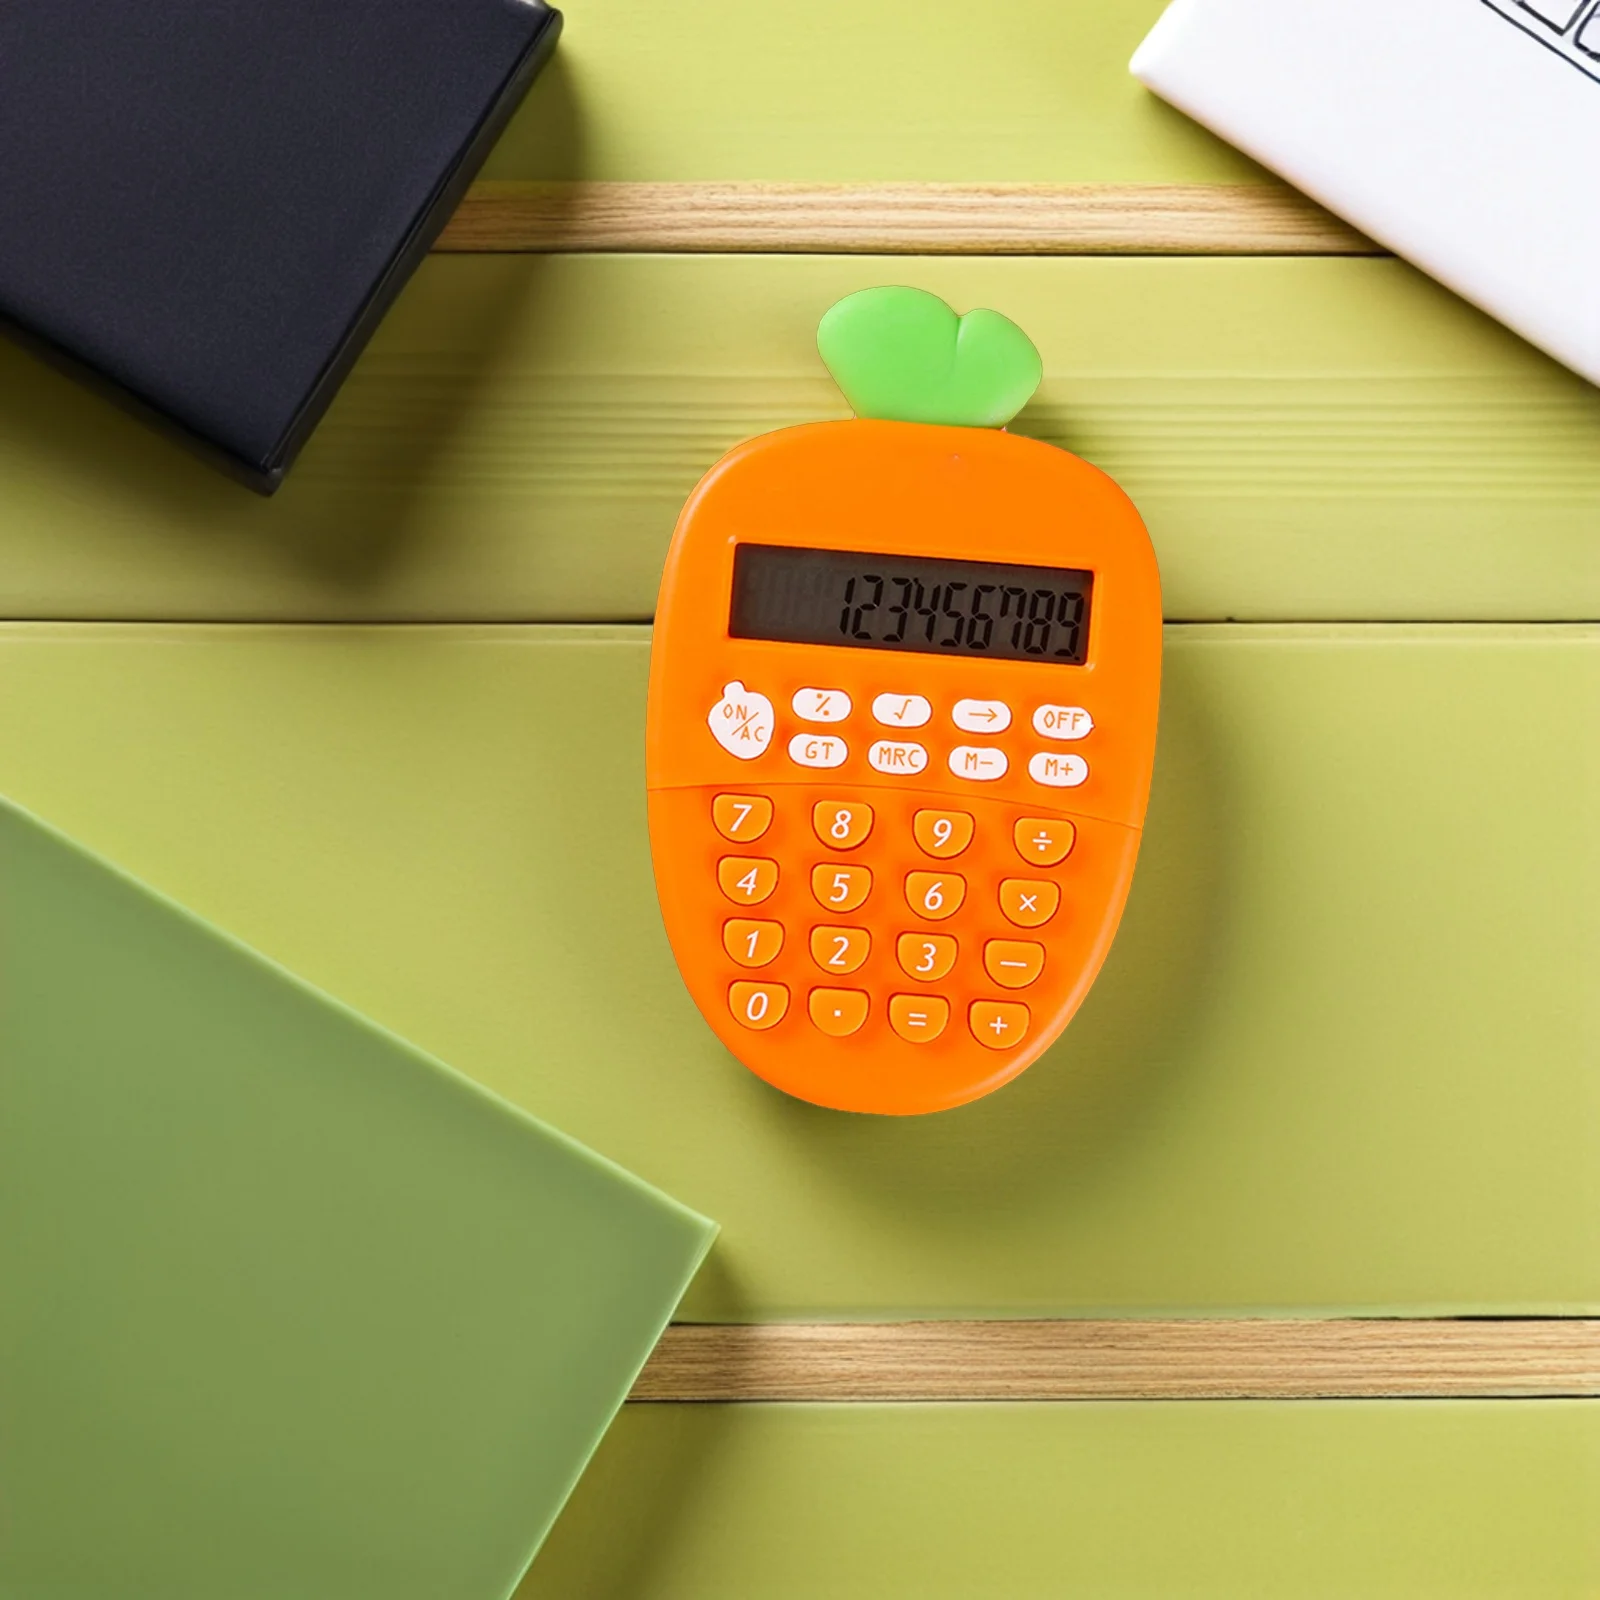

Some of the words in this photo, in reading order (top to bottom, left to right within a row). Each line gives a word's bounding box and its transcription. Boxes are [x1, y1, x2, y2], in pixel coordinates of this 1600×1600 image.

[1043, 709, 1085, 732] OFF
[804, 741, 835, 760] GT
[878, 746, 921, 769] MRC
[964, 752, 994, 771] M-
[1044, 758, 1074, 777] M+
[730, 803, 753, 832] 7
[830, 809, 852, 839] 8
[933, 818, 953, 848] 9
[736, 867, 758, 896] 4
[829, 873, 851, 903] 5
[924, 881, 944, 911] 6
[746, 930, 759, 958] 1
[828, 936, 849, 966] 2
[915, 942, 937, 972] 3
[746, 991, 769, 1021] 0
